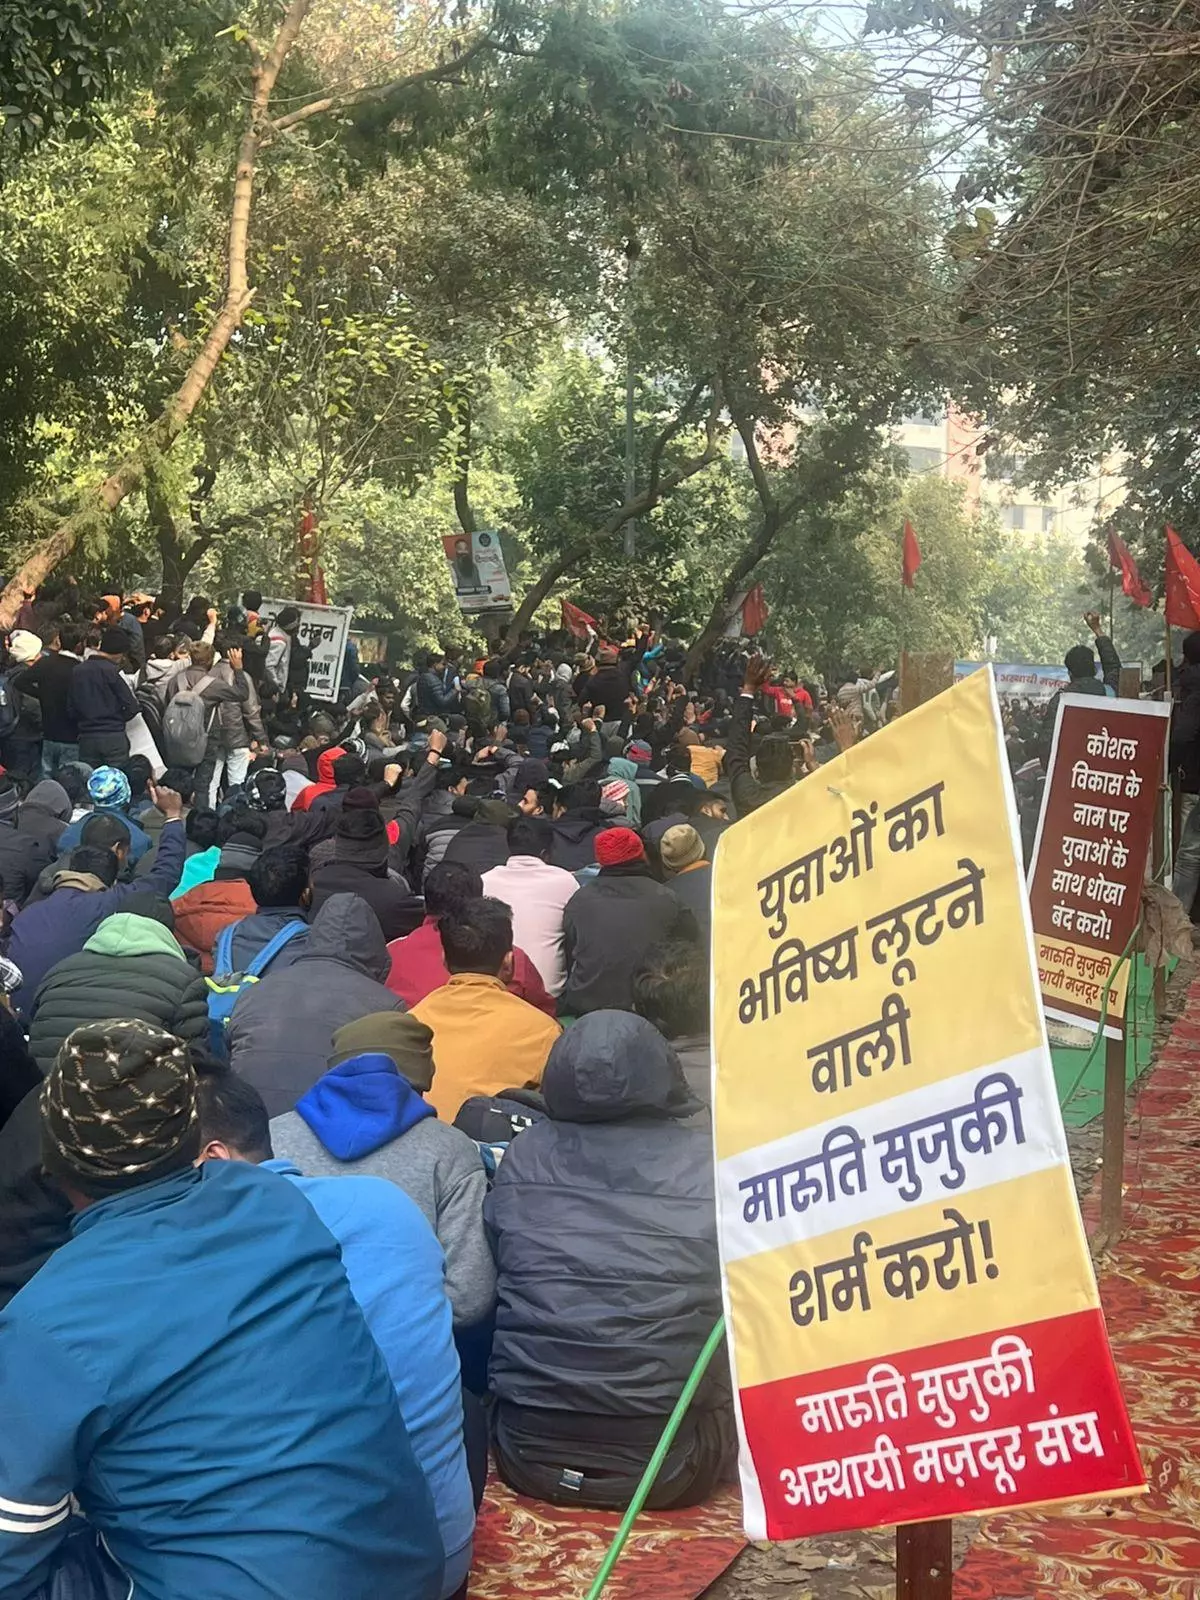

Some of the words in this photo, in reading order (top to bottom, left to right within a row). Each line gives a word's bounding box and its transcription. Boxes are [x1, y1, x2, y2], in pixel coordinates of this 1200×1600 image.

[1087, 727, 1138, 761] कौशल
[1071, 761, 1124, 795] विकास
[1125, 769, 1142, 798] के
[1074, 803, 1107, 828] नाम
[1109, 810, 1130, 833] पर
[758, 801, 877, 939] युवाओं
[884, 781, 944, 852] का
[1062, 836, 1113, 867] युवाओं
[1112, 840, 1129, 868] के
[1052, 869, 1086, 896] साथ
[1086, 872, 1126, 906] धोखा
[1052, 900, 1075, 930] बंद
[1077, 910, 1111, 940] करो!
[739, 938, 858, 1024] भविष्य
[866, 858, 985, 986] लूटने
[1040, 944, 1076, 968] मारुति
[1076, 954, 1112, 980] सुजुकी
[1065, 976, 1100, 1005] मज़दूर
[807, 993, 911, 1093] वाली
[739, 1126, 866, 1222] मारुति
[873, 1073, 1025, 1201] सुजुकी
[790, 1232, 872, 1326] शर्म
[875, 1209, 998, 1300] करो!
[796, 1362, 908, 1433] मारुति
[911, 1334, 1034, 1428] सुजुकी
[780, 1434, 905, 1505] अस्थायी
[906, 1426, 1025, 1493] मज़दूर
[1028, 1404, 1103, 1465] संघ
